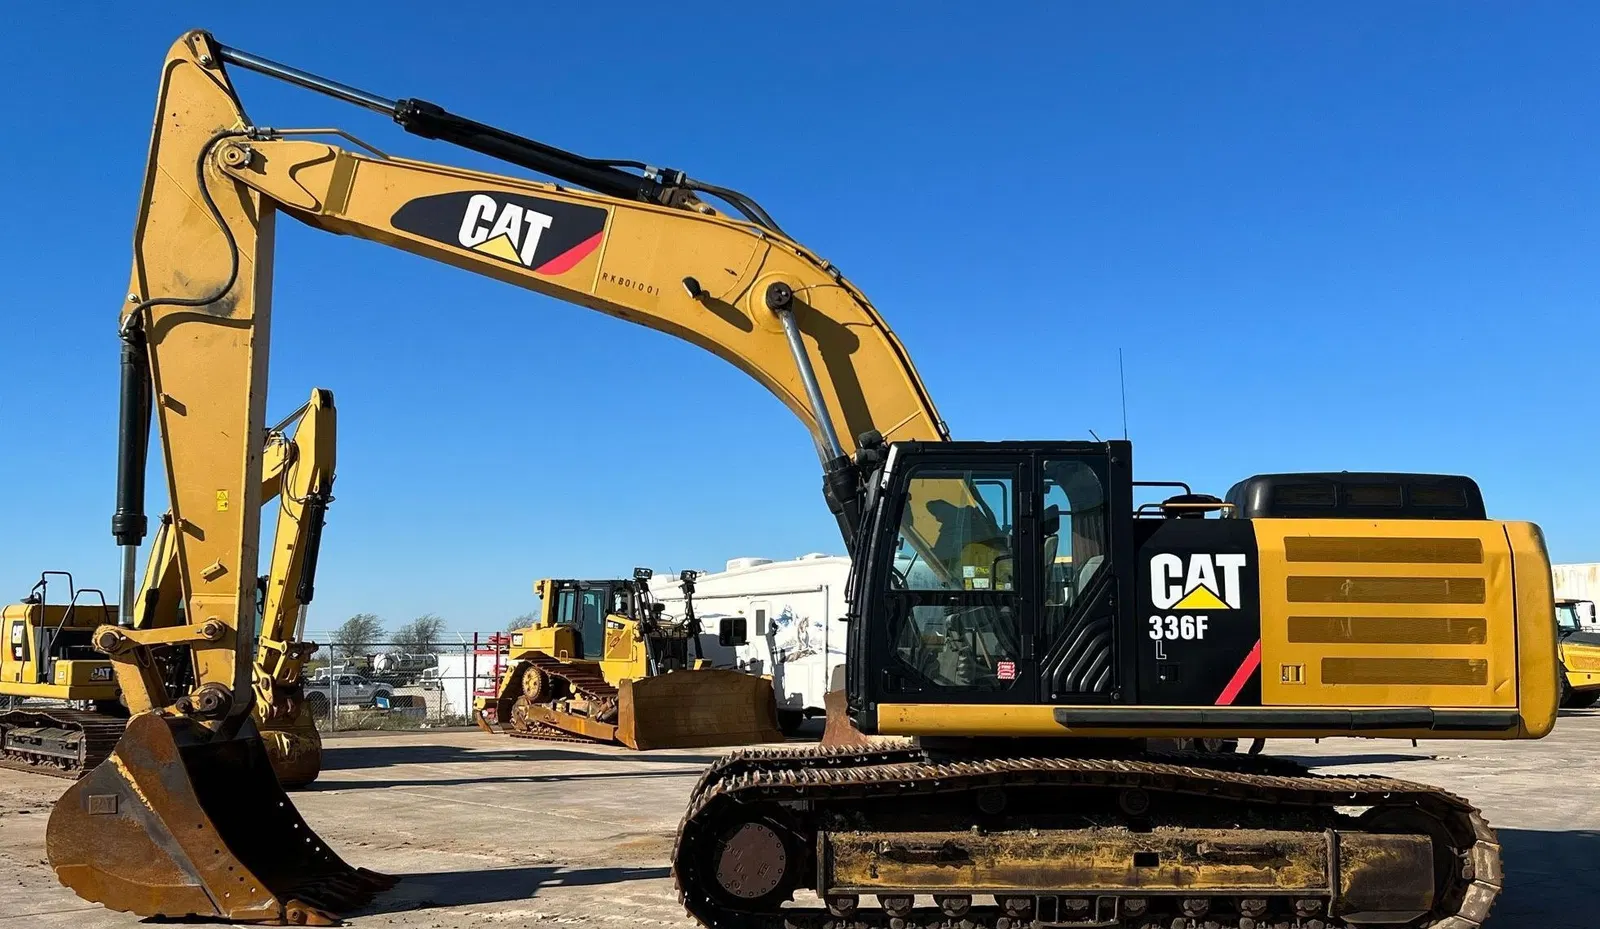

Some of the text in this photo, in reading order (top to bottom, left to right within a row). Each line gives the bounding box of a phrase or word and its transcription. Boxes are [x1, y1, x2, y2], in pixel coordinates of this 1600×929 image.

[458, 194, 553, 267] CAT
[602, 272, 660, 296] RKB01001
[1150, 553, 1246, 610] CAT
[1148, 615, 1208, 640] 336F
[1155, 640, 1167, 660] L
